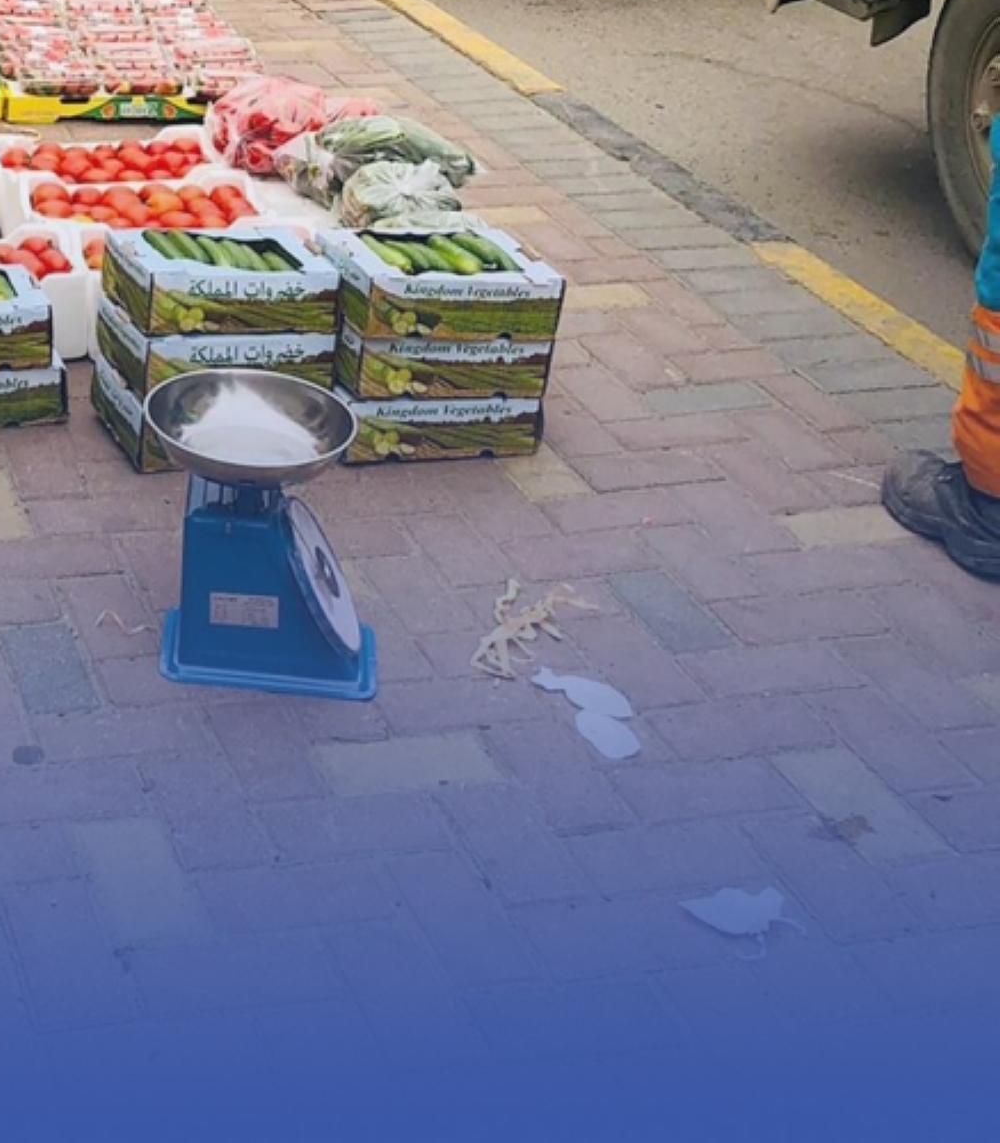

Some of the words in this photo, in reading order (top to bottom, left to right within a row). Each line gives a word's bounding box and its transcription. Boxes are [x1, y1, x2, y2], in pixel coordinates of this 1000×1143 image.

[187, 278, 238, 299] المملكة
[244, 279, 306, 301] خضروات
[404, 285, 464, 299] Kingdom
[467, 284, 531, 300] Vegetables
[388, 342, 450, 356] Kingdom
[455, 340, 525, 356] Vegetables
[376, 405, 438, 419] Kingdom
[443, 404, 513, 419] Vegetables
